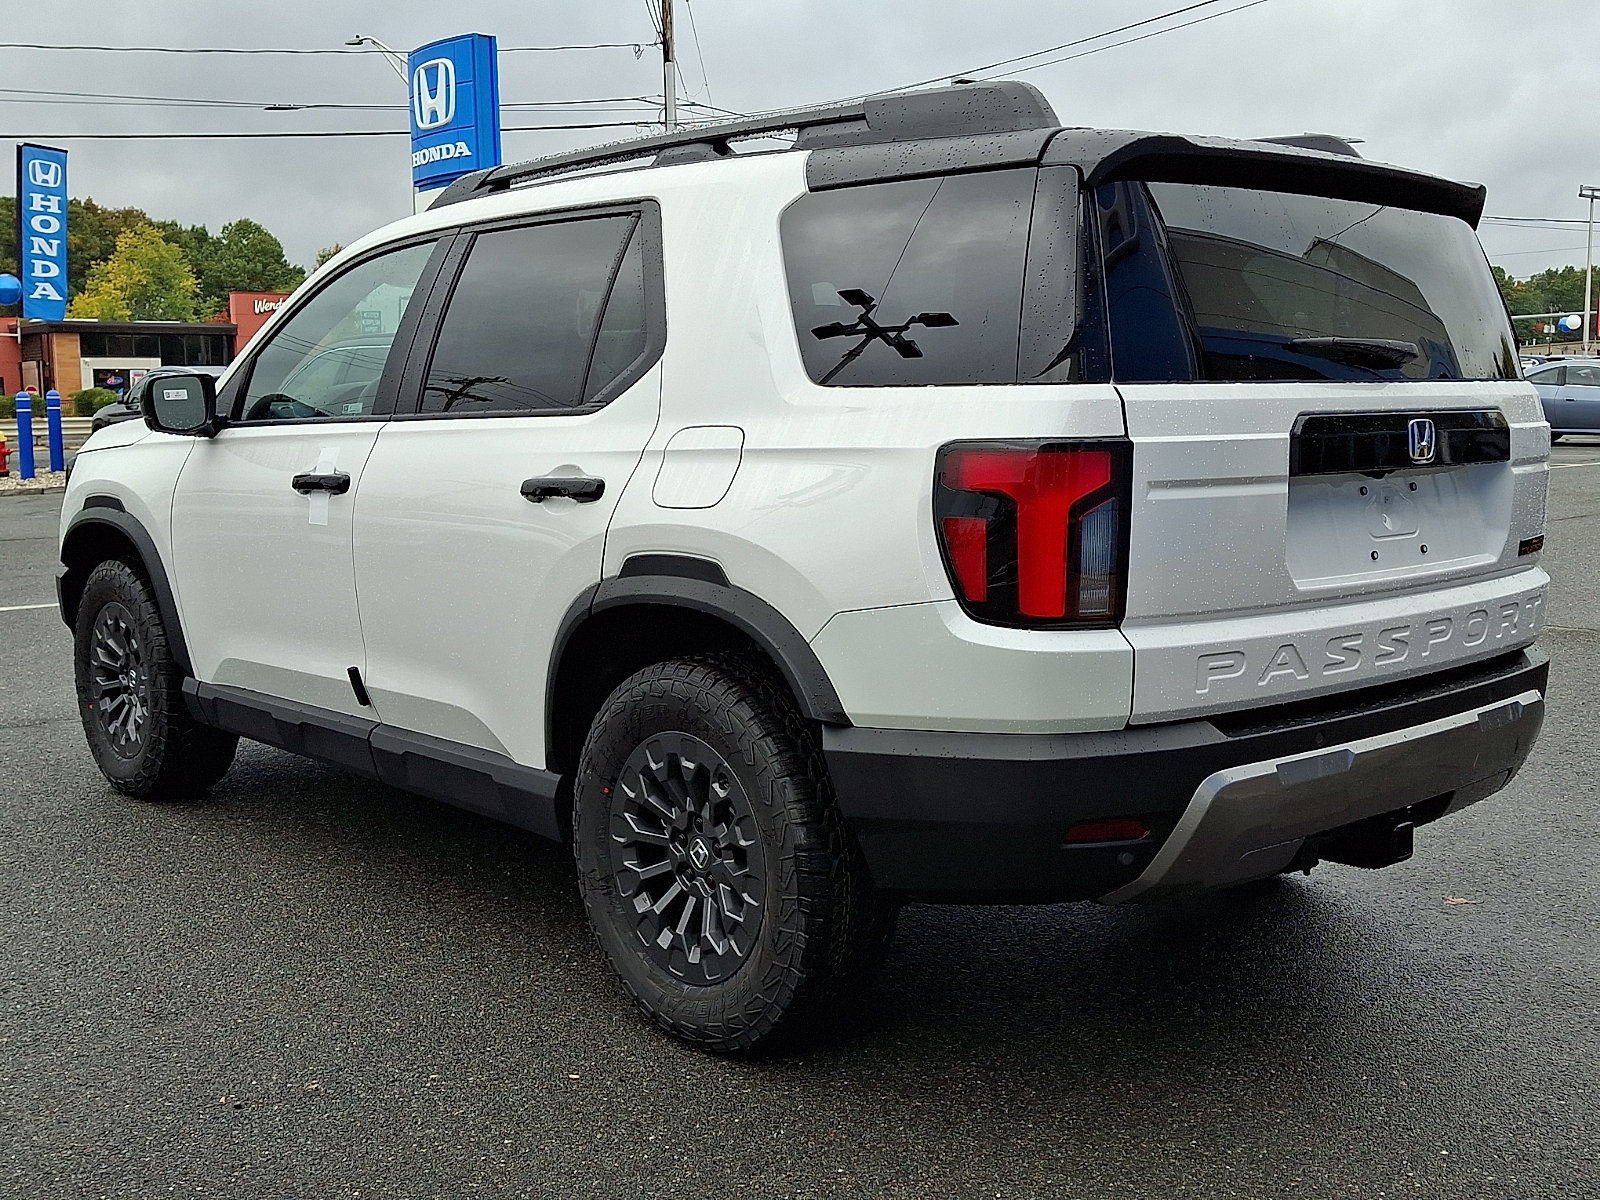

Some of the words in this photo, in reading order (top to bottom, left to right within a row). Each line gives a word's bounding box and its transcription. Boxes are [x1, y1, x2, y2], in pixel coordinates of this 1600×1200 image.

[411, 142, 472, 167] HONDA
[29, 193, 63, 300] HONDA
[254, 298, 284, 314] Wend
[1195, 594, 1542, 694] PASSPORT
